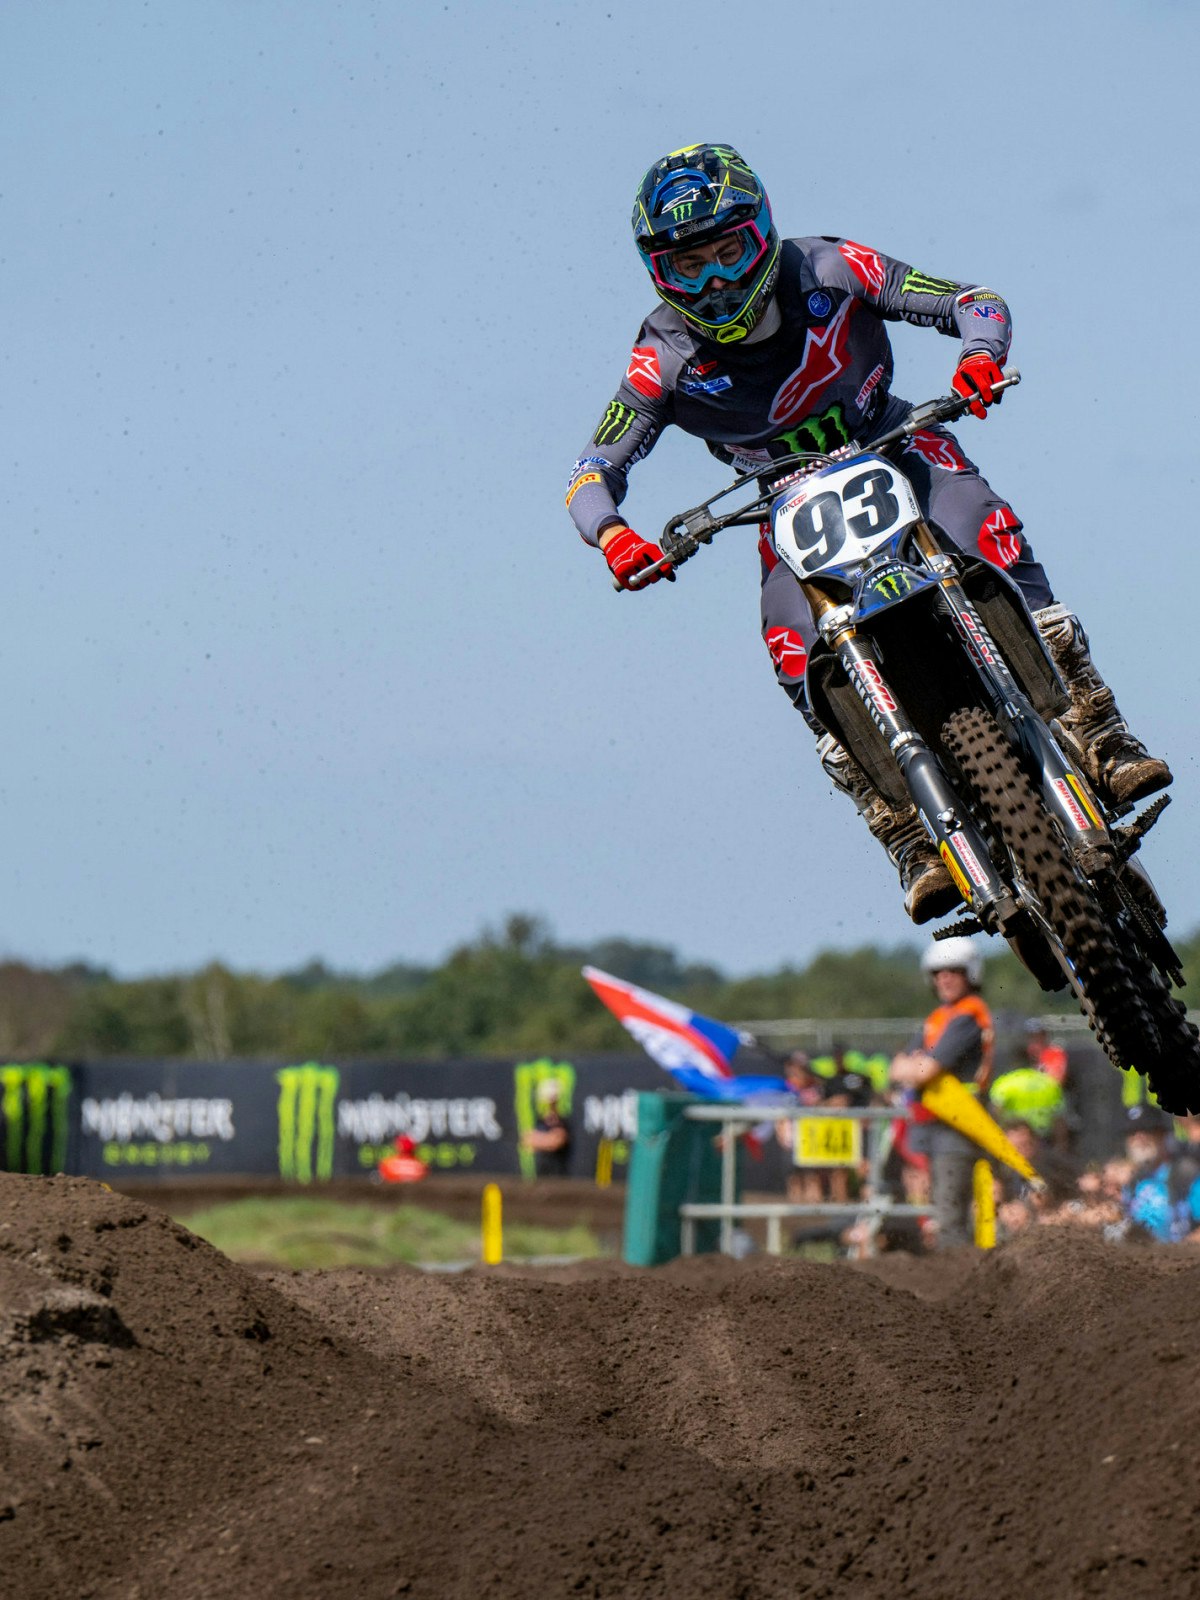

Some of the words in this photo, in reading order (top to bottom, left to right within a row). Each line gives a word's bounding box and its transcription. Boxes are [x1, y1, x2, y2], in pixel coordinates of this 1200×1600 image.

[861, 367, 884, 397] YAMAHA
[779, 493, 808, 517] MXGP
[792, 468, 900, 572] 93
[866, 565, 911, 589] YAMAHA
[1055, 780, 1088, 830] BRAKING
